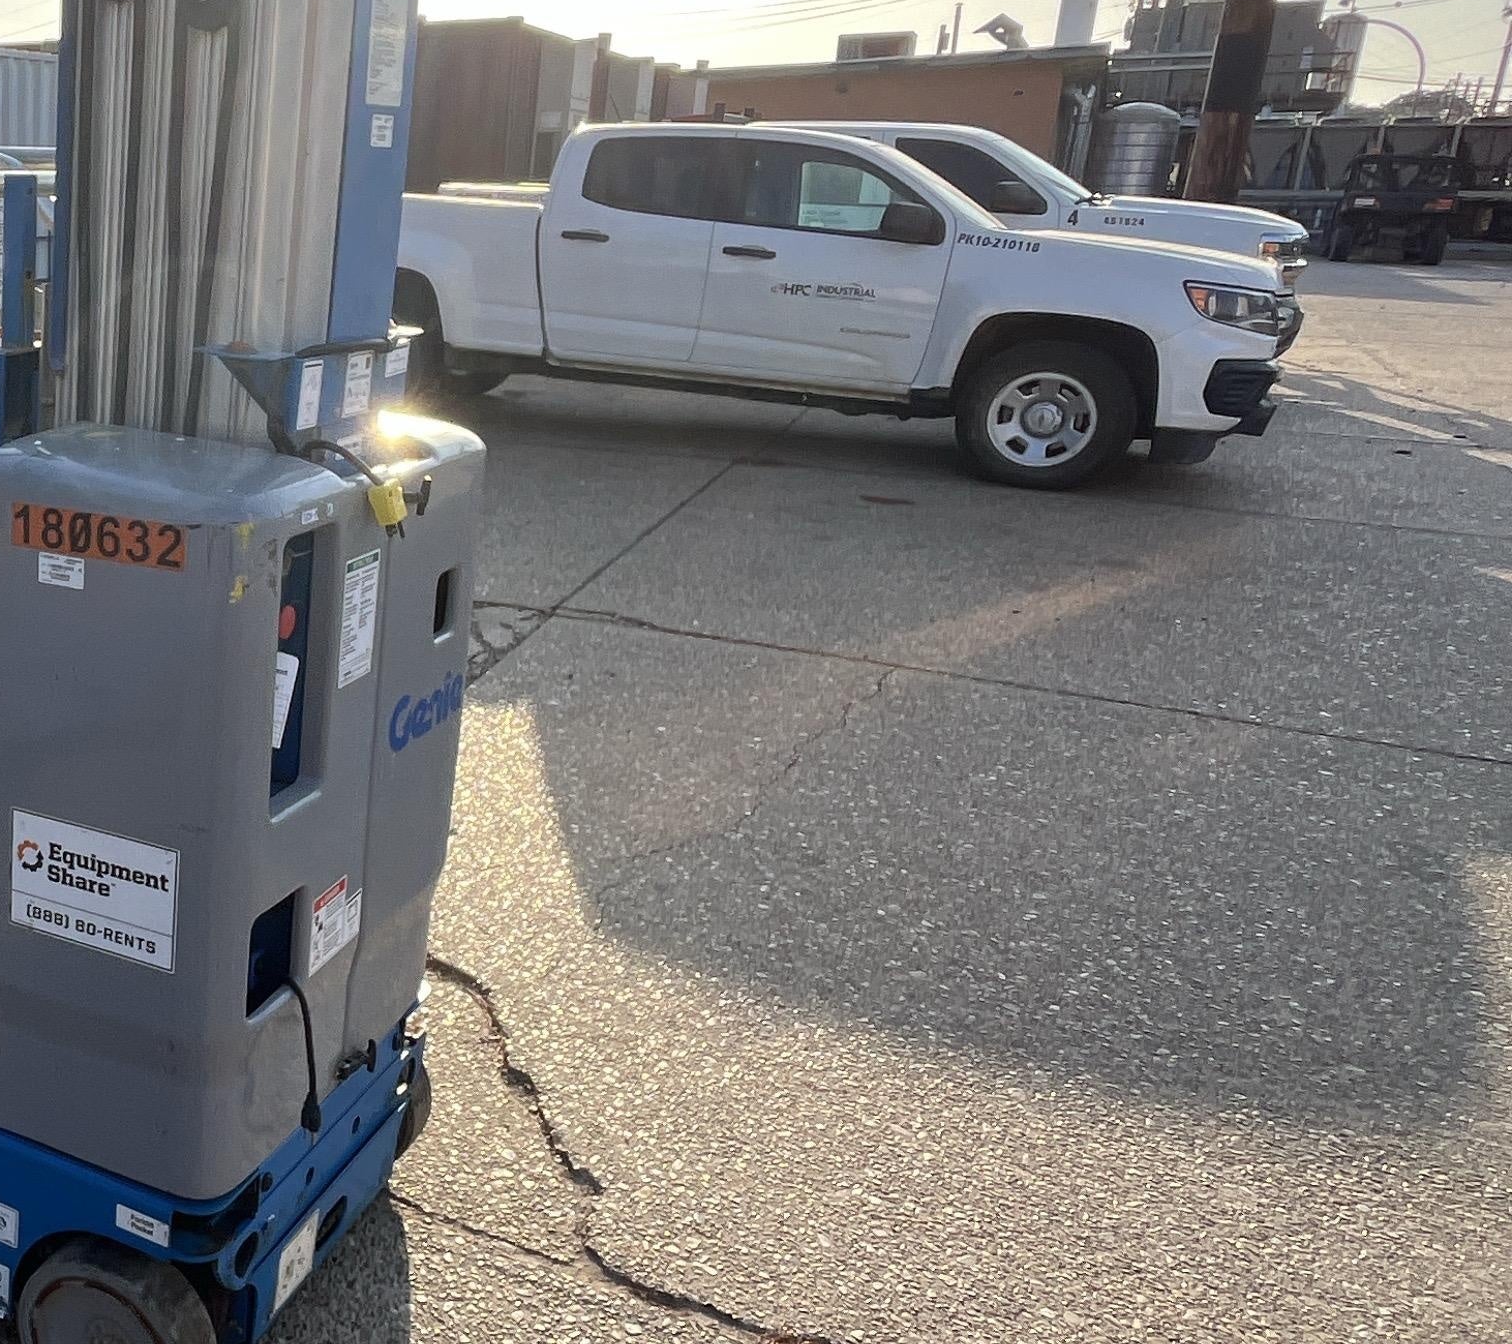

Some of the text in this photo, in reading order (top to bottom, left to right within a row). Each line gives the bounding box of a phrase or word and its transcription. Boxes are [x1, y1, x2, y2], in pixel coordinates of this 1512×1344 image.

[1067, 210, 1079, 226] 4
[783, 283, 876, 298] HPC INDUSTRIAL
[14, 504, 182, 568] 180632
[47, 864, 111, 897] Share
[48, 842, 169, 892] Equipment
[26, 904, 156, 955] (888) 80-RENTS
